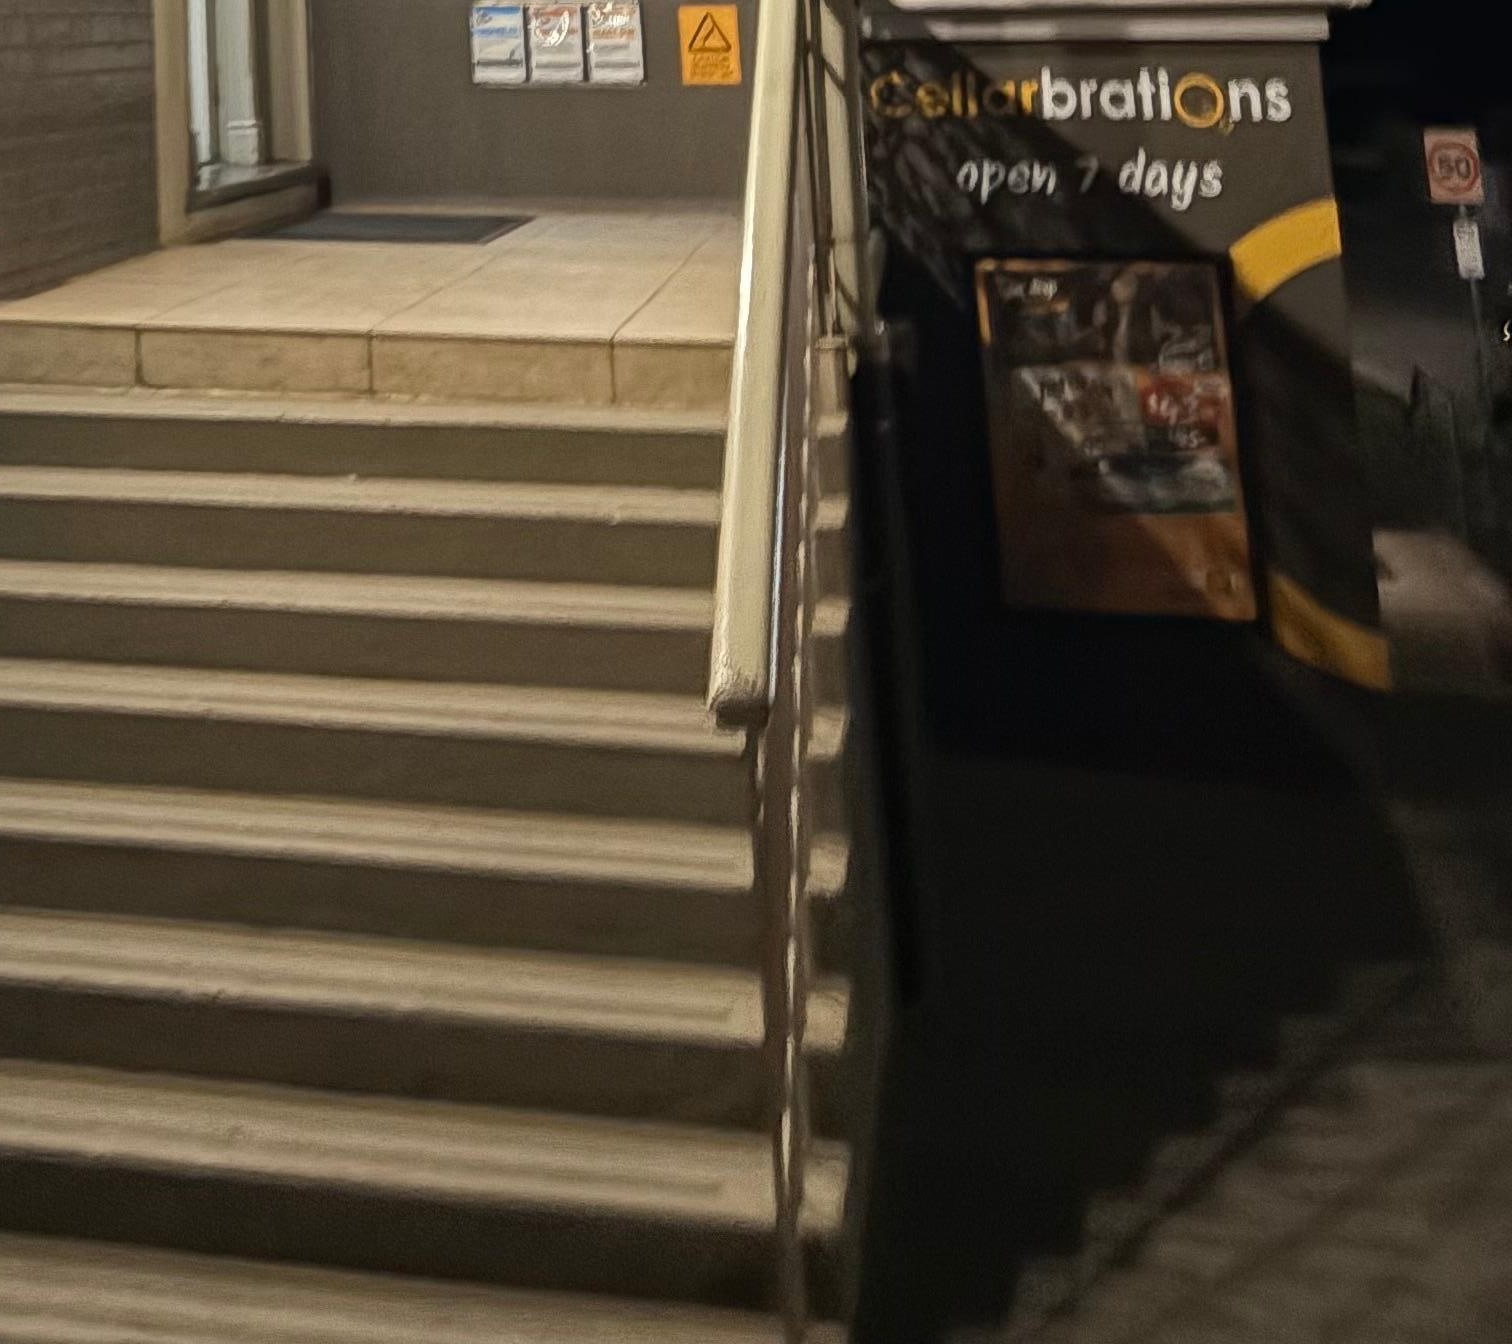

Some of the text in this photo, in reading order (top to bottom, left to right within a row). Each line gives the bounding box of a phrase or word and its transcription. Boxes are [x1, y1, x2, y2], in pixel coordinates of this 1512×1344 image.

[870, 66, 1293, 130] Cellarbrations
[955, 146, 1224, 212] open 7 days
